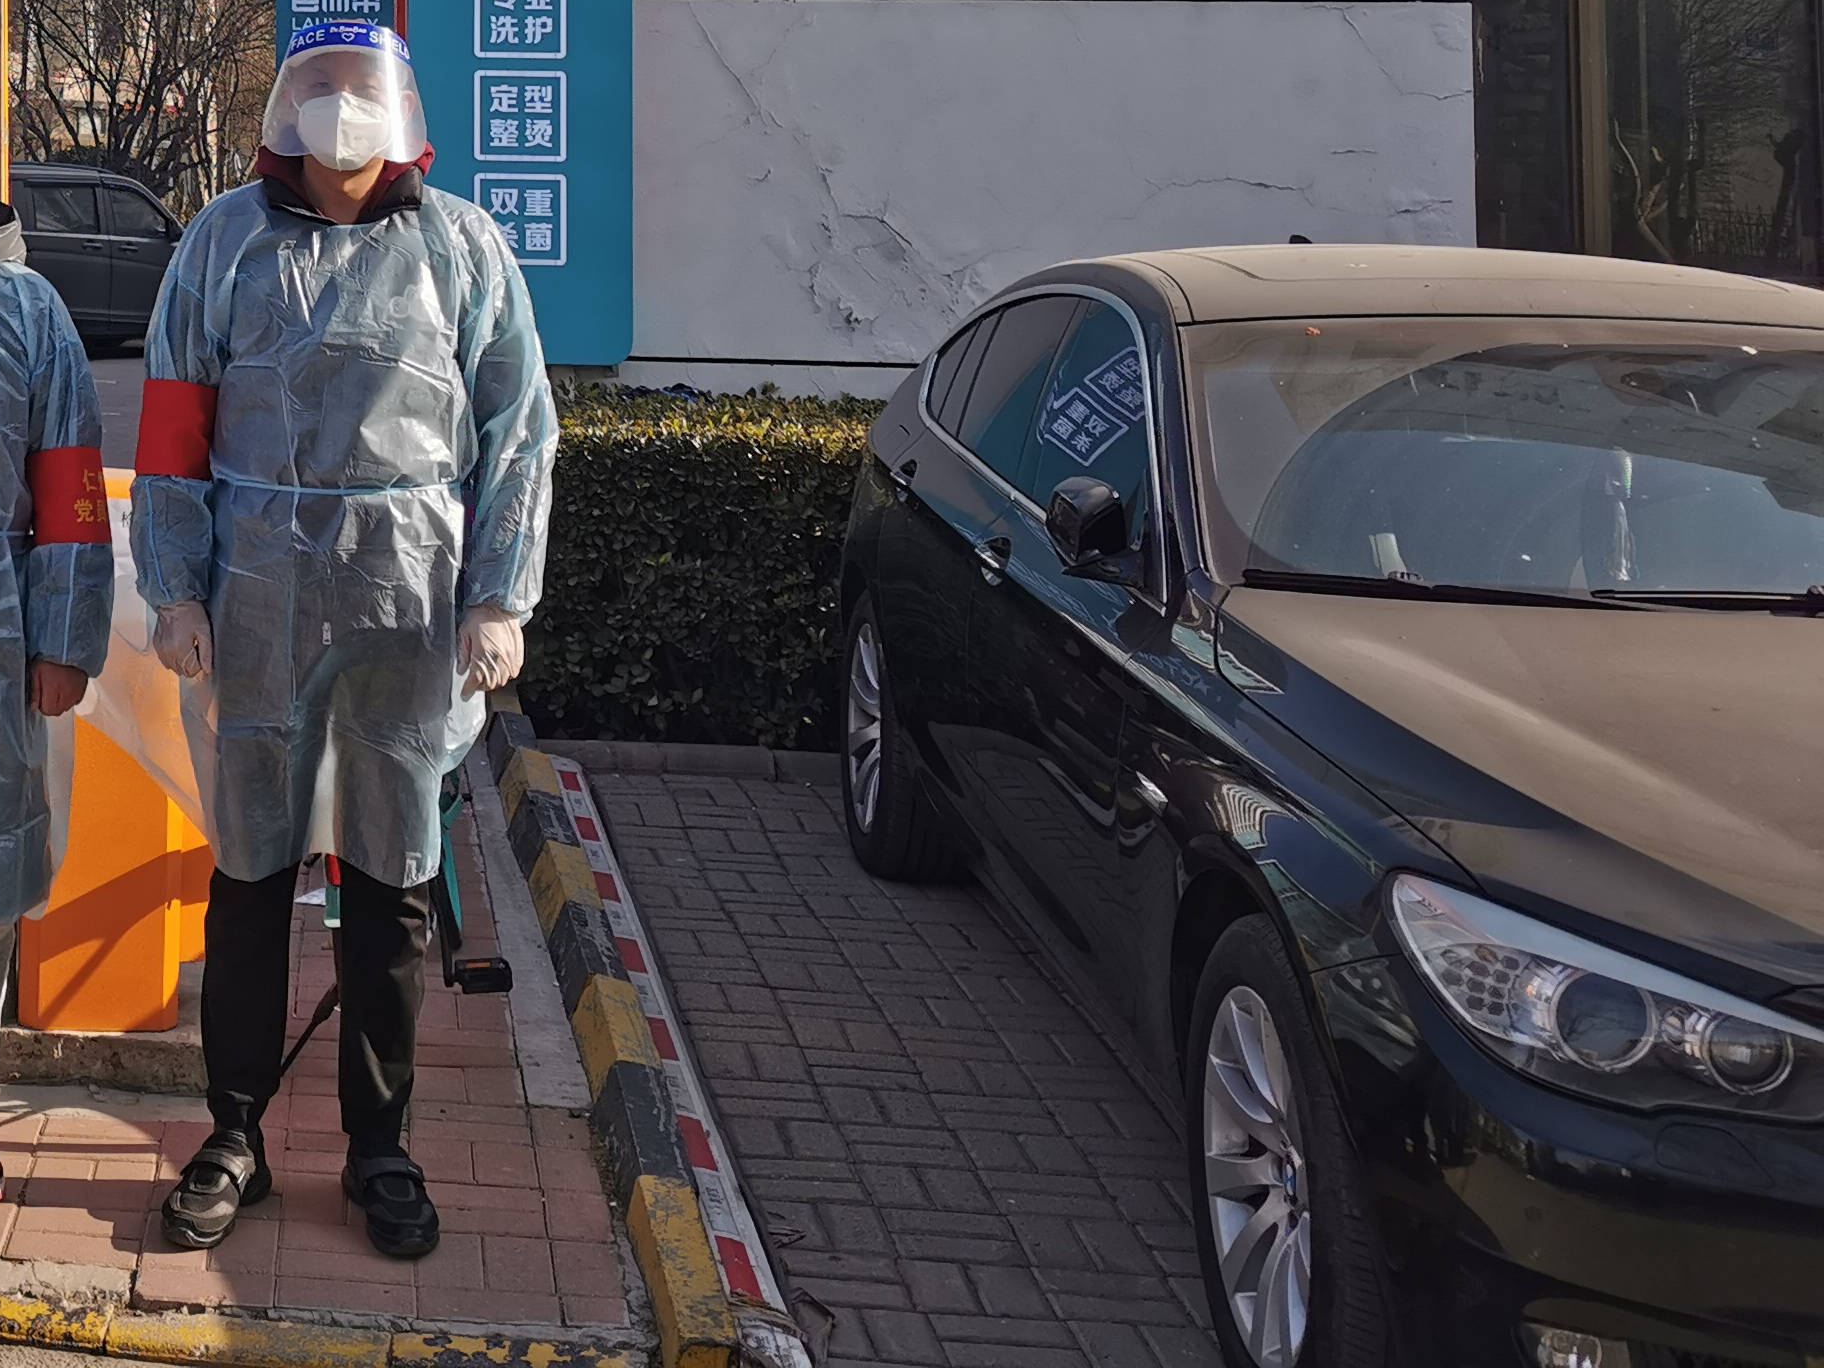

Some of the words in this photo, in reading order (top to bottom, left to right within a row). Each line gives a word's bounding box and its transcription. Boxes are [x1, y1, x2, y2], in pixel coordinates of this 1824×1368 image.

[290, 29, 326, 51] FACE
[489, 15, 553, 44] 洗护
[489, 85, 553, 114] 定型
[489, 118, 553, 148] 整烫
[489, 188, 553, 217] 双重
